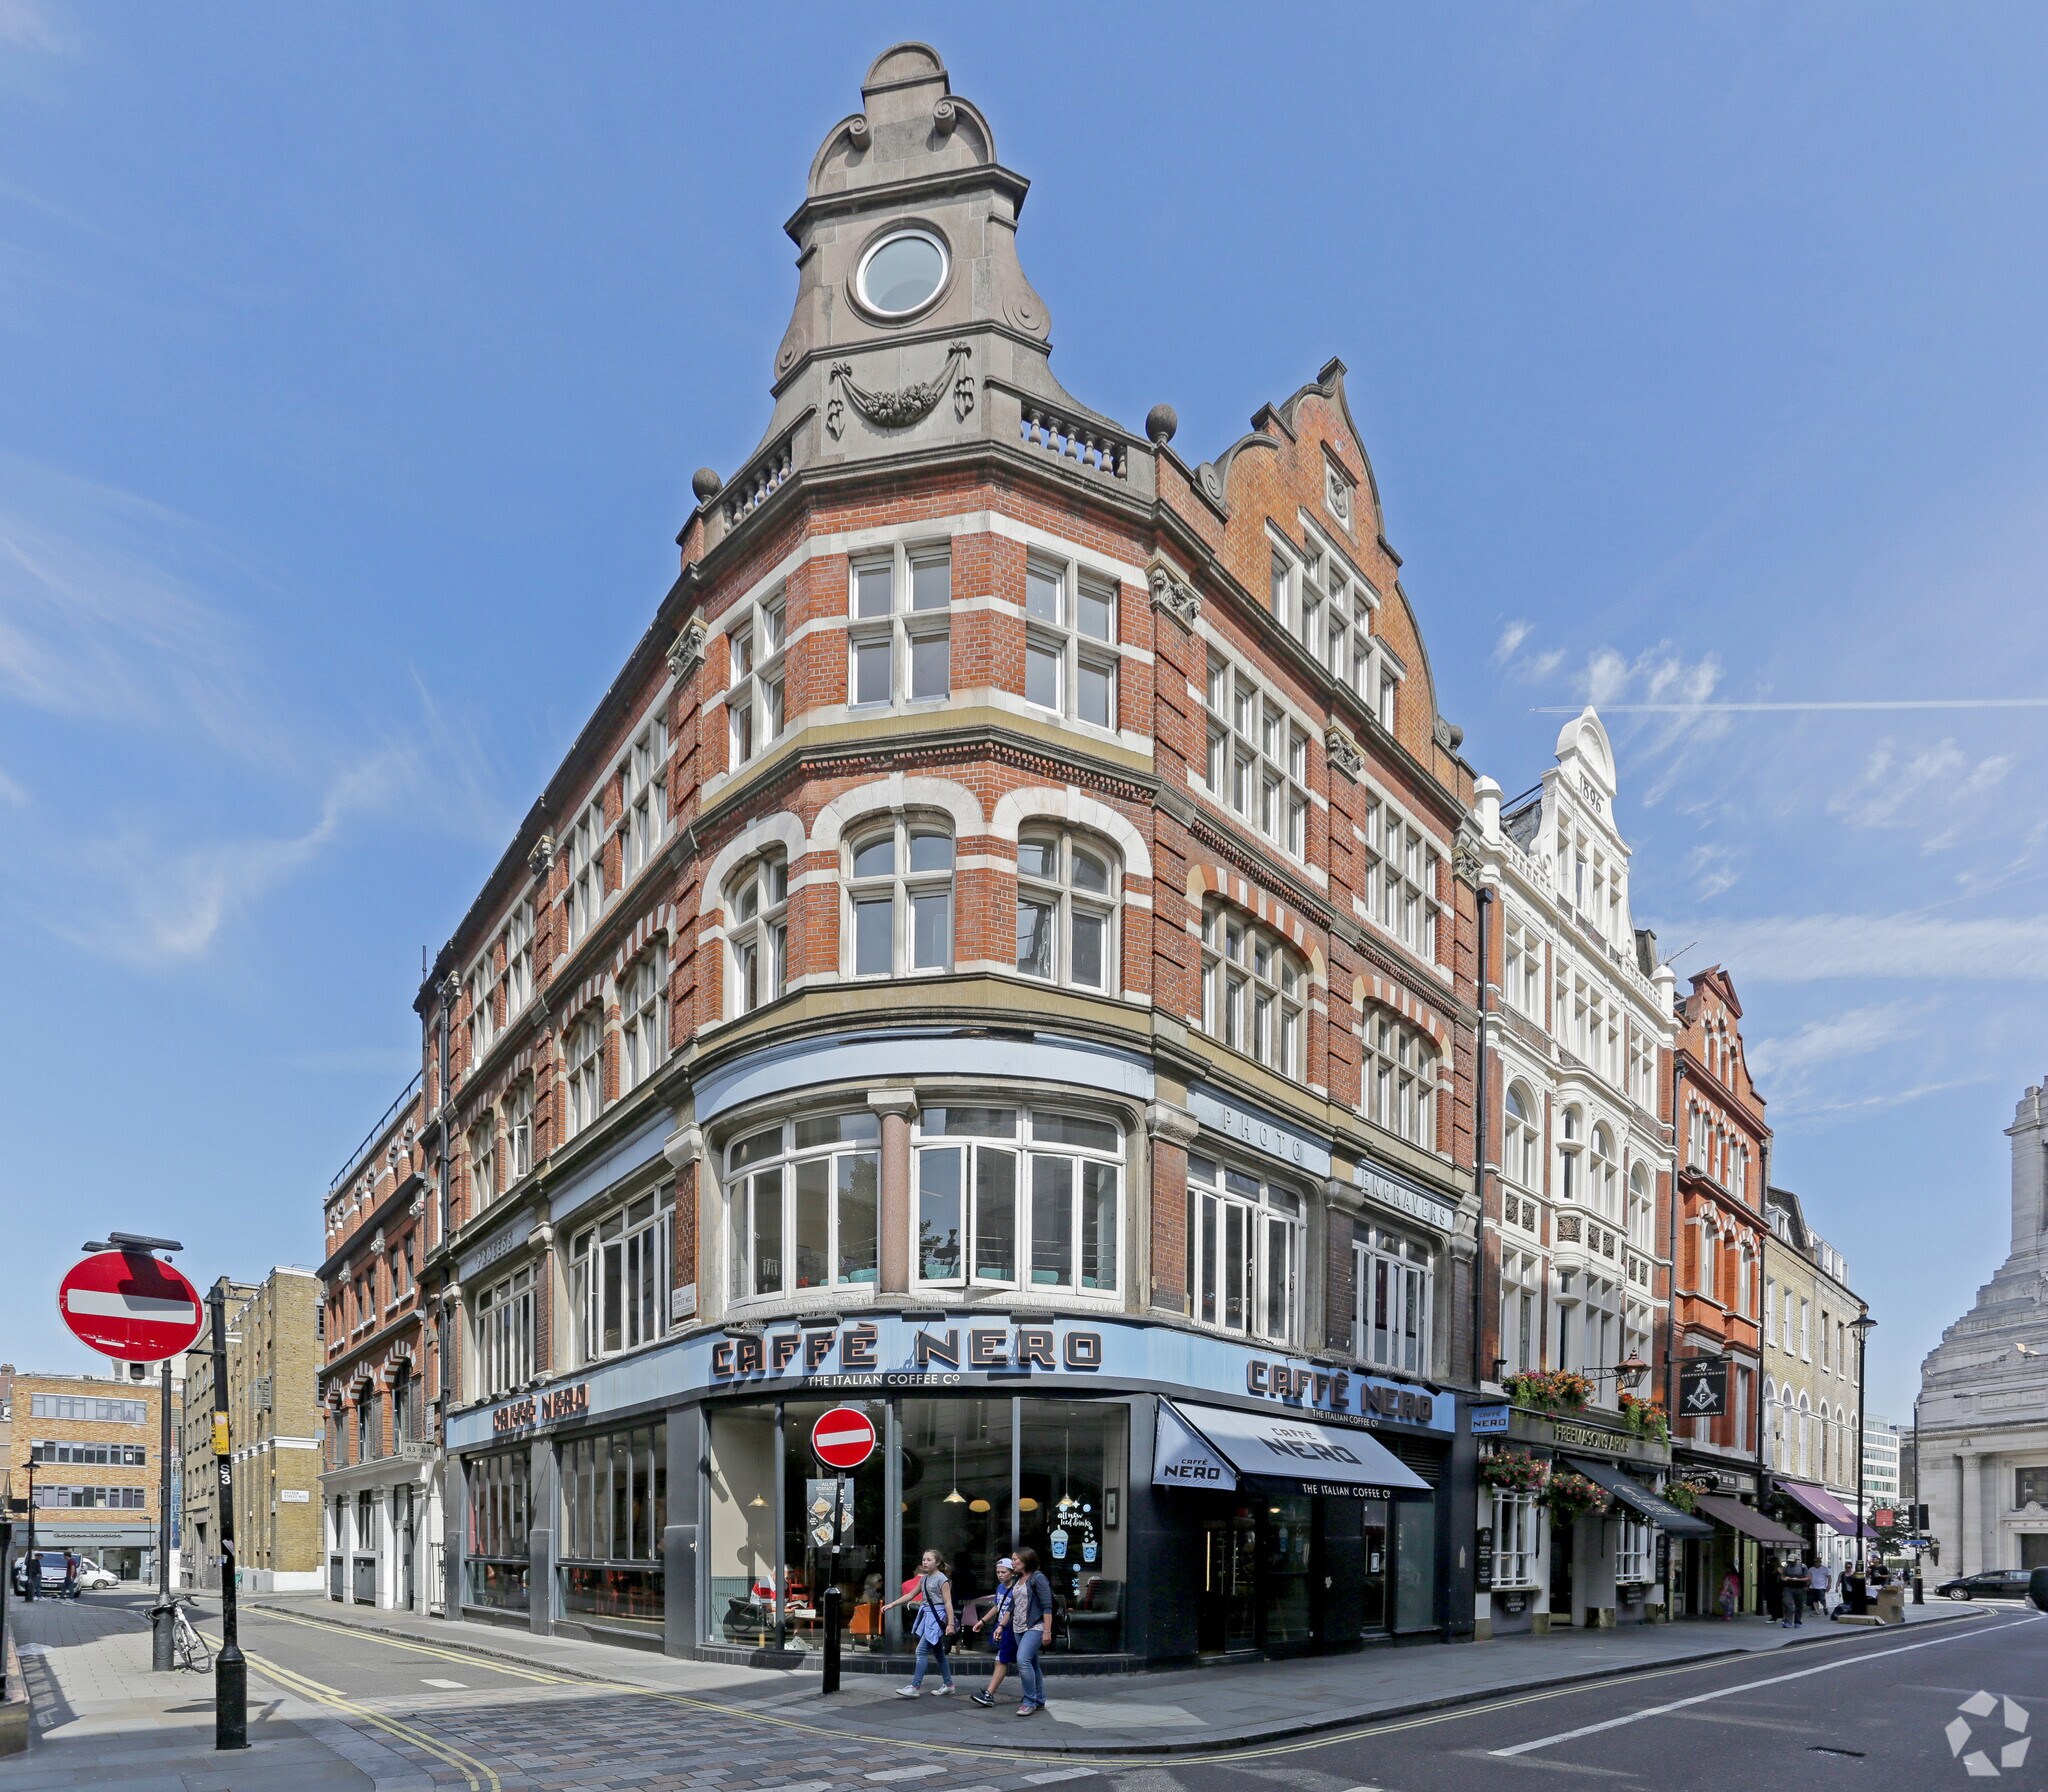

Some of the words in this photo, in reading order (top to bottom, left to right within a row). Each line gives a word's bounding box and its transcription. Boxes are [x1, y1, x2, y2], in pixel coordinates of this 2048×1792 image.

[1580, 774, 1602, 813] 1896
[1223, 1106, 1301, 1161] PHOTO
[1361, 1170, 1446, 1226] ENGRAVERS
[476, 1231, 513, 1269] PROCESS
[712, 1321, 879, 1376] CAFFÈ
[916, 1328, 1102, 1367] NERO
[808, 1376, 830, 1387] THE
[832, 1374, 883, 1386] ITALIAN
[887, 1374, 938, 1385] COFFEE
[1247, 1360, 1350, 1407] CAFFÈ
[1361, 1383, 1433, 1421] NERO
[541, 1381, 590, 1420] NERO
[1699, 1393, 1707, 1403] F
[1312, 1409, 1325, 1419] THE
[1325, 1411, 1349, 1423] ITALIAN
[1349, 1415, 1371, 1427] COFFEE
[1473, 1419, 1507, 1428] NERO
[1256, 1435, 1363, 1465] NERO
[1555, 1424, 1609, 1449] FREEMASONS
[1608, 1435, 1629, 1453] ARMS
[1164, 1465, 1221, 1480] NERO
[1302, 1483, 1318, 1494] THE
[1321, 1484, 1350, 1496] ITALIAN
[1353, 1487, 1380, 1498] COFFEE
[1057, 1511, 1068, 1520] all
